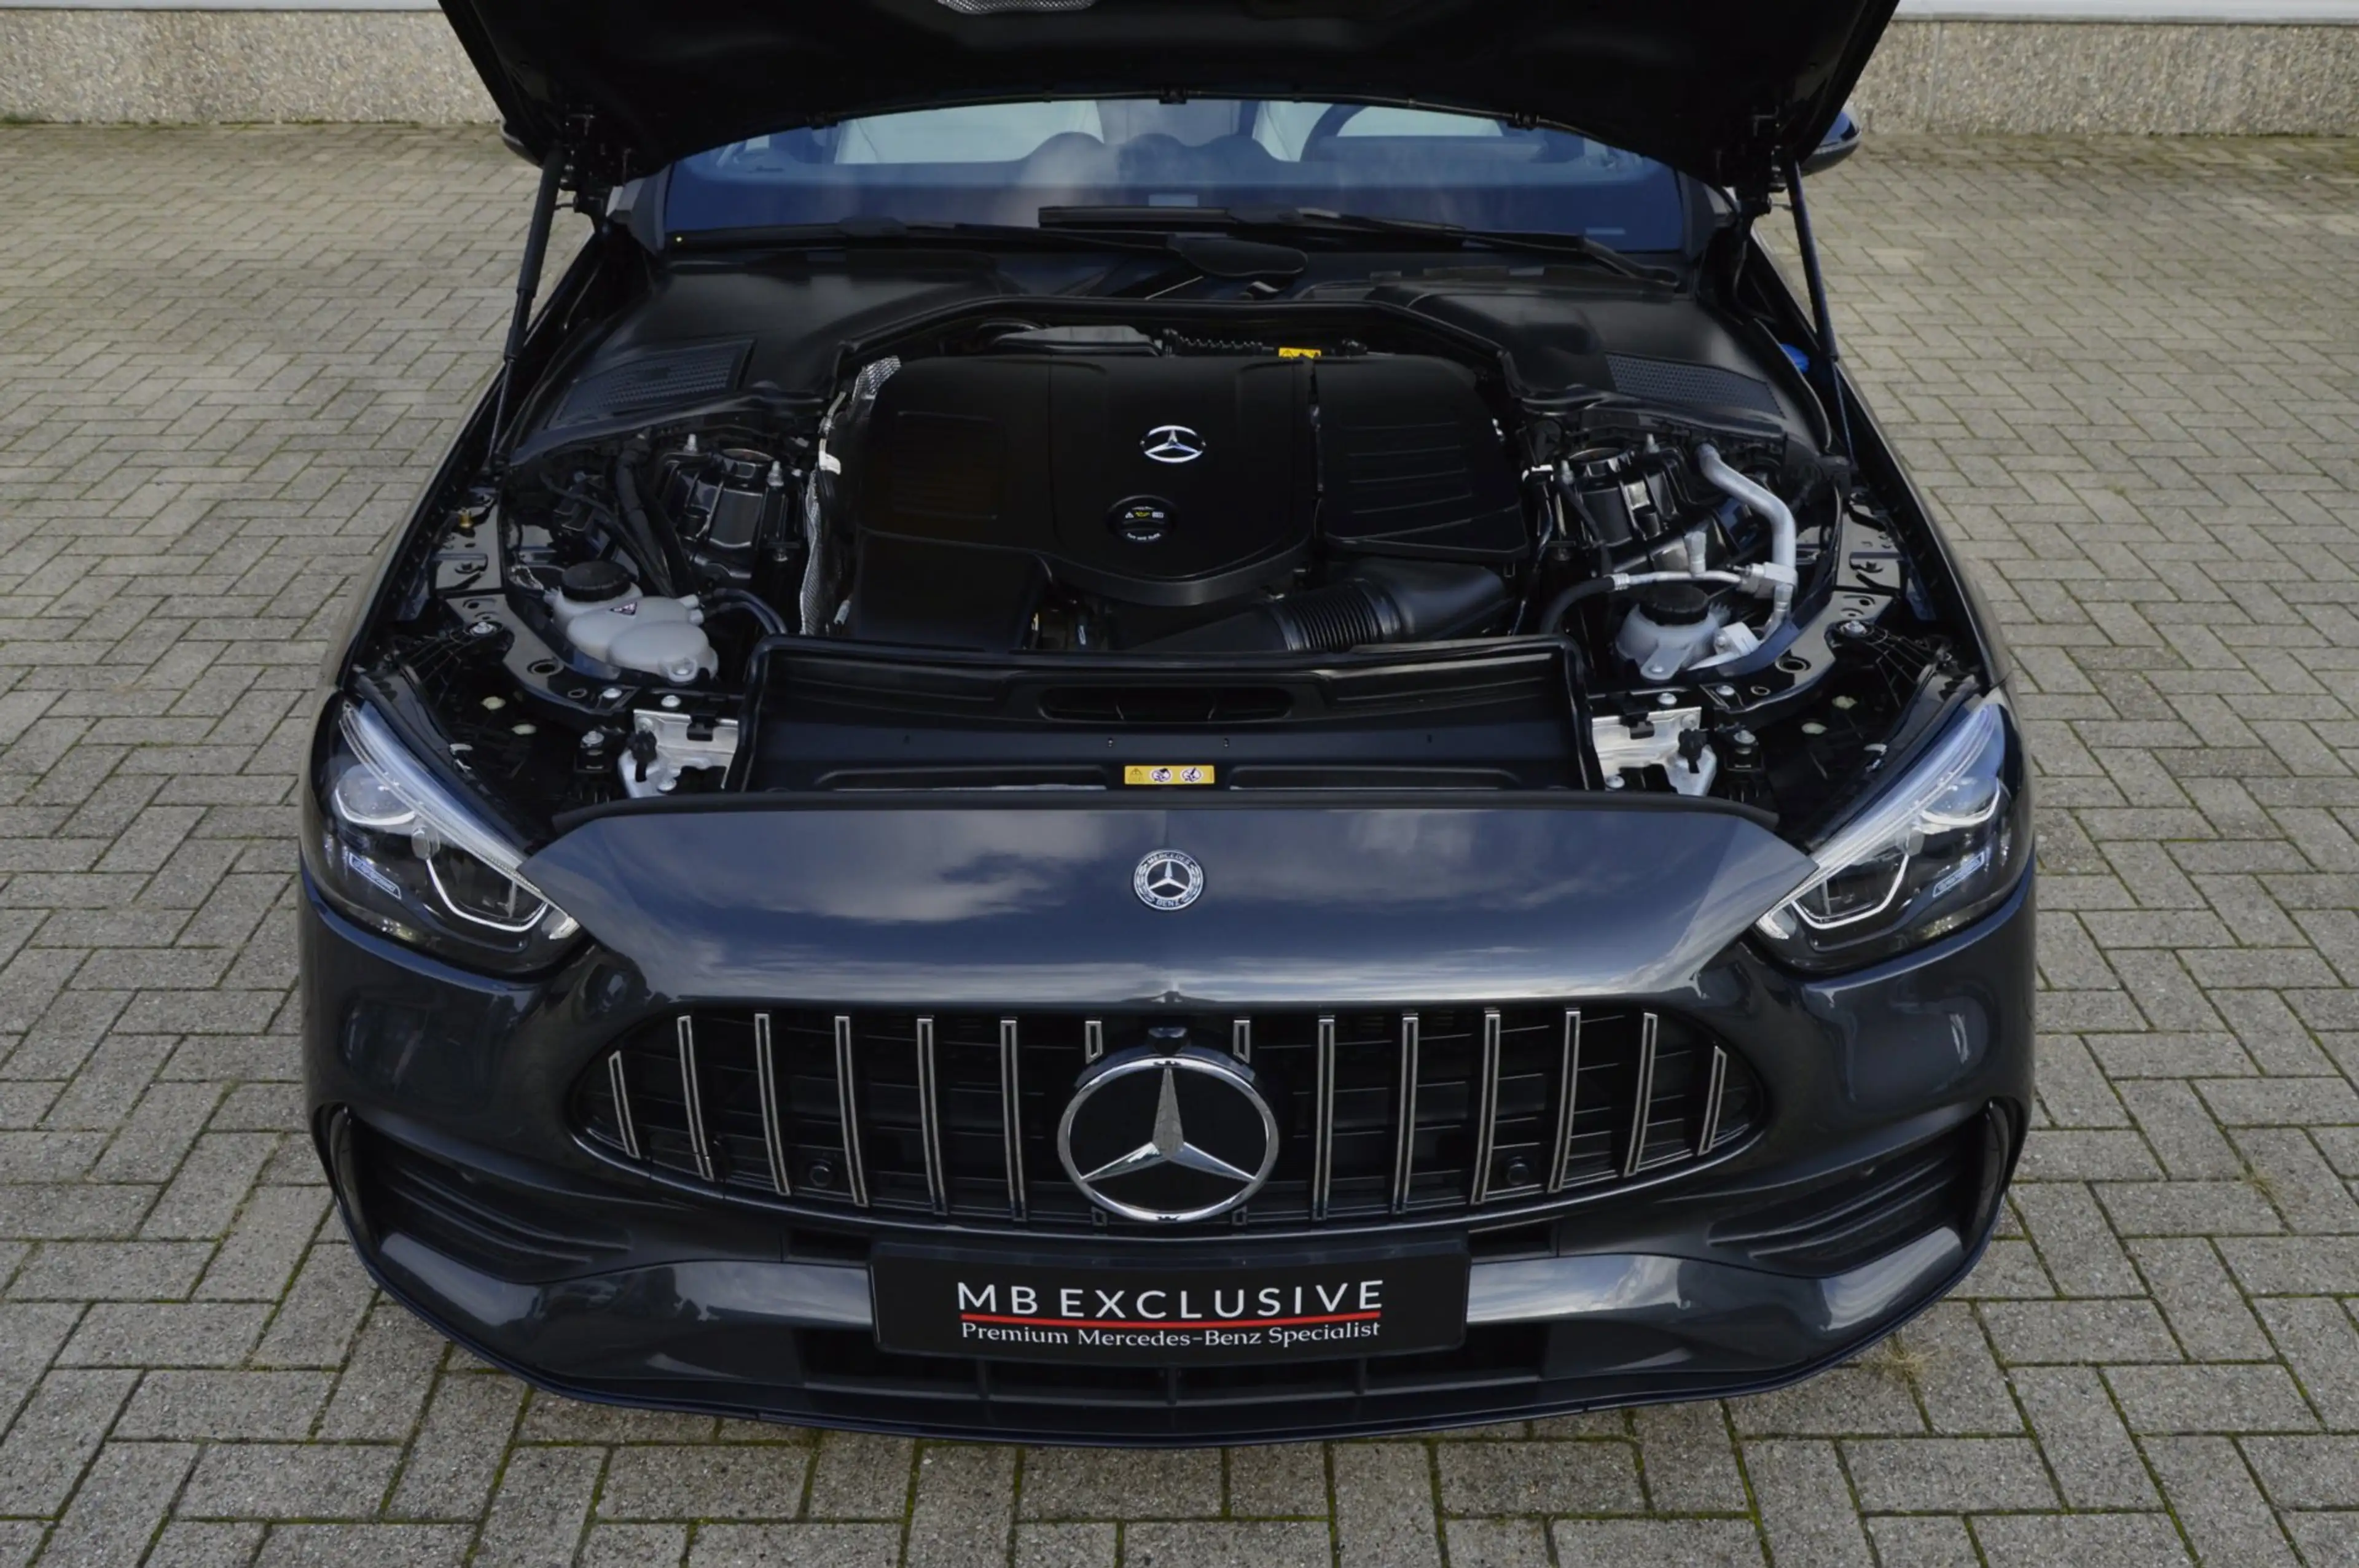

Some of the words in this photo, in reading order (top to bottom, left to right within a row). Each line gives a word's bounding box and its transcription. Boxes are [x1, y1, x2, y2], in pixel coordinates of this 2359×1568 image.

[958, 1282, 1038, 1314] MB
[1060, 1280, 1383, 1319] EXCLUSIVE
[962, 1322, 1068, 1344] Premium
[1078, 1329, 1261, 1346] Mercedes-Benz
[1269, 1322, 1380, 1348] Specialist
